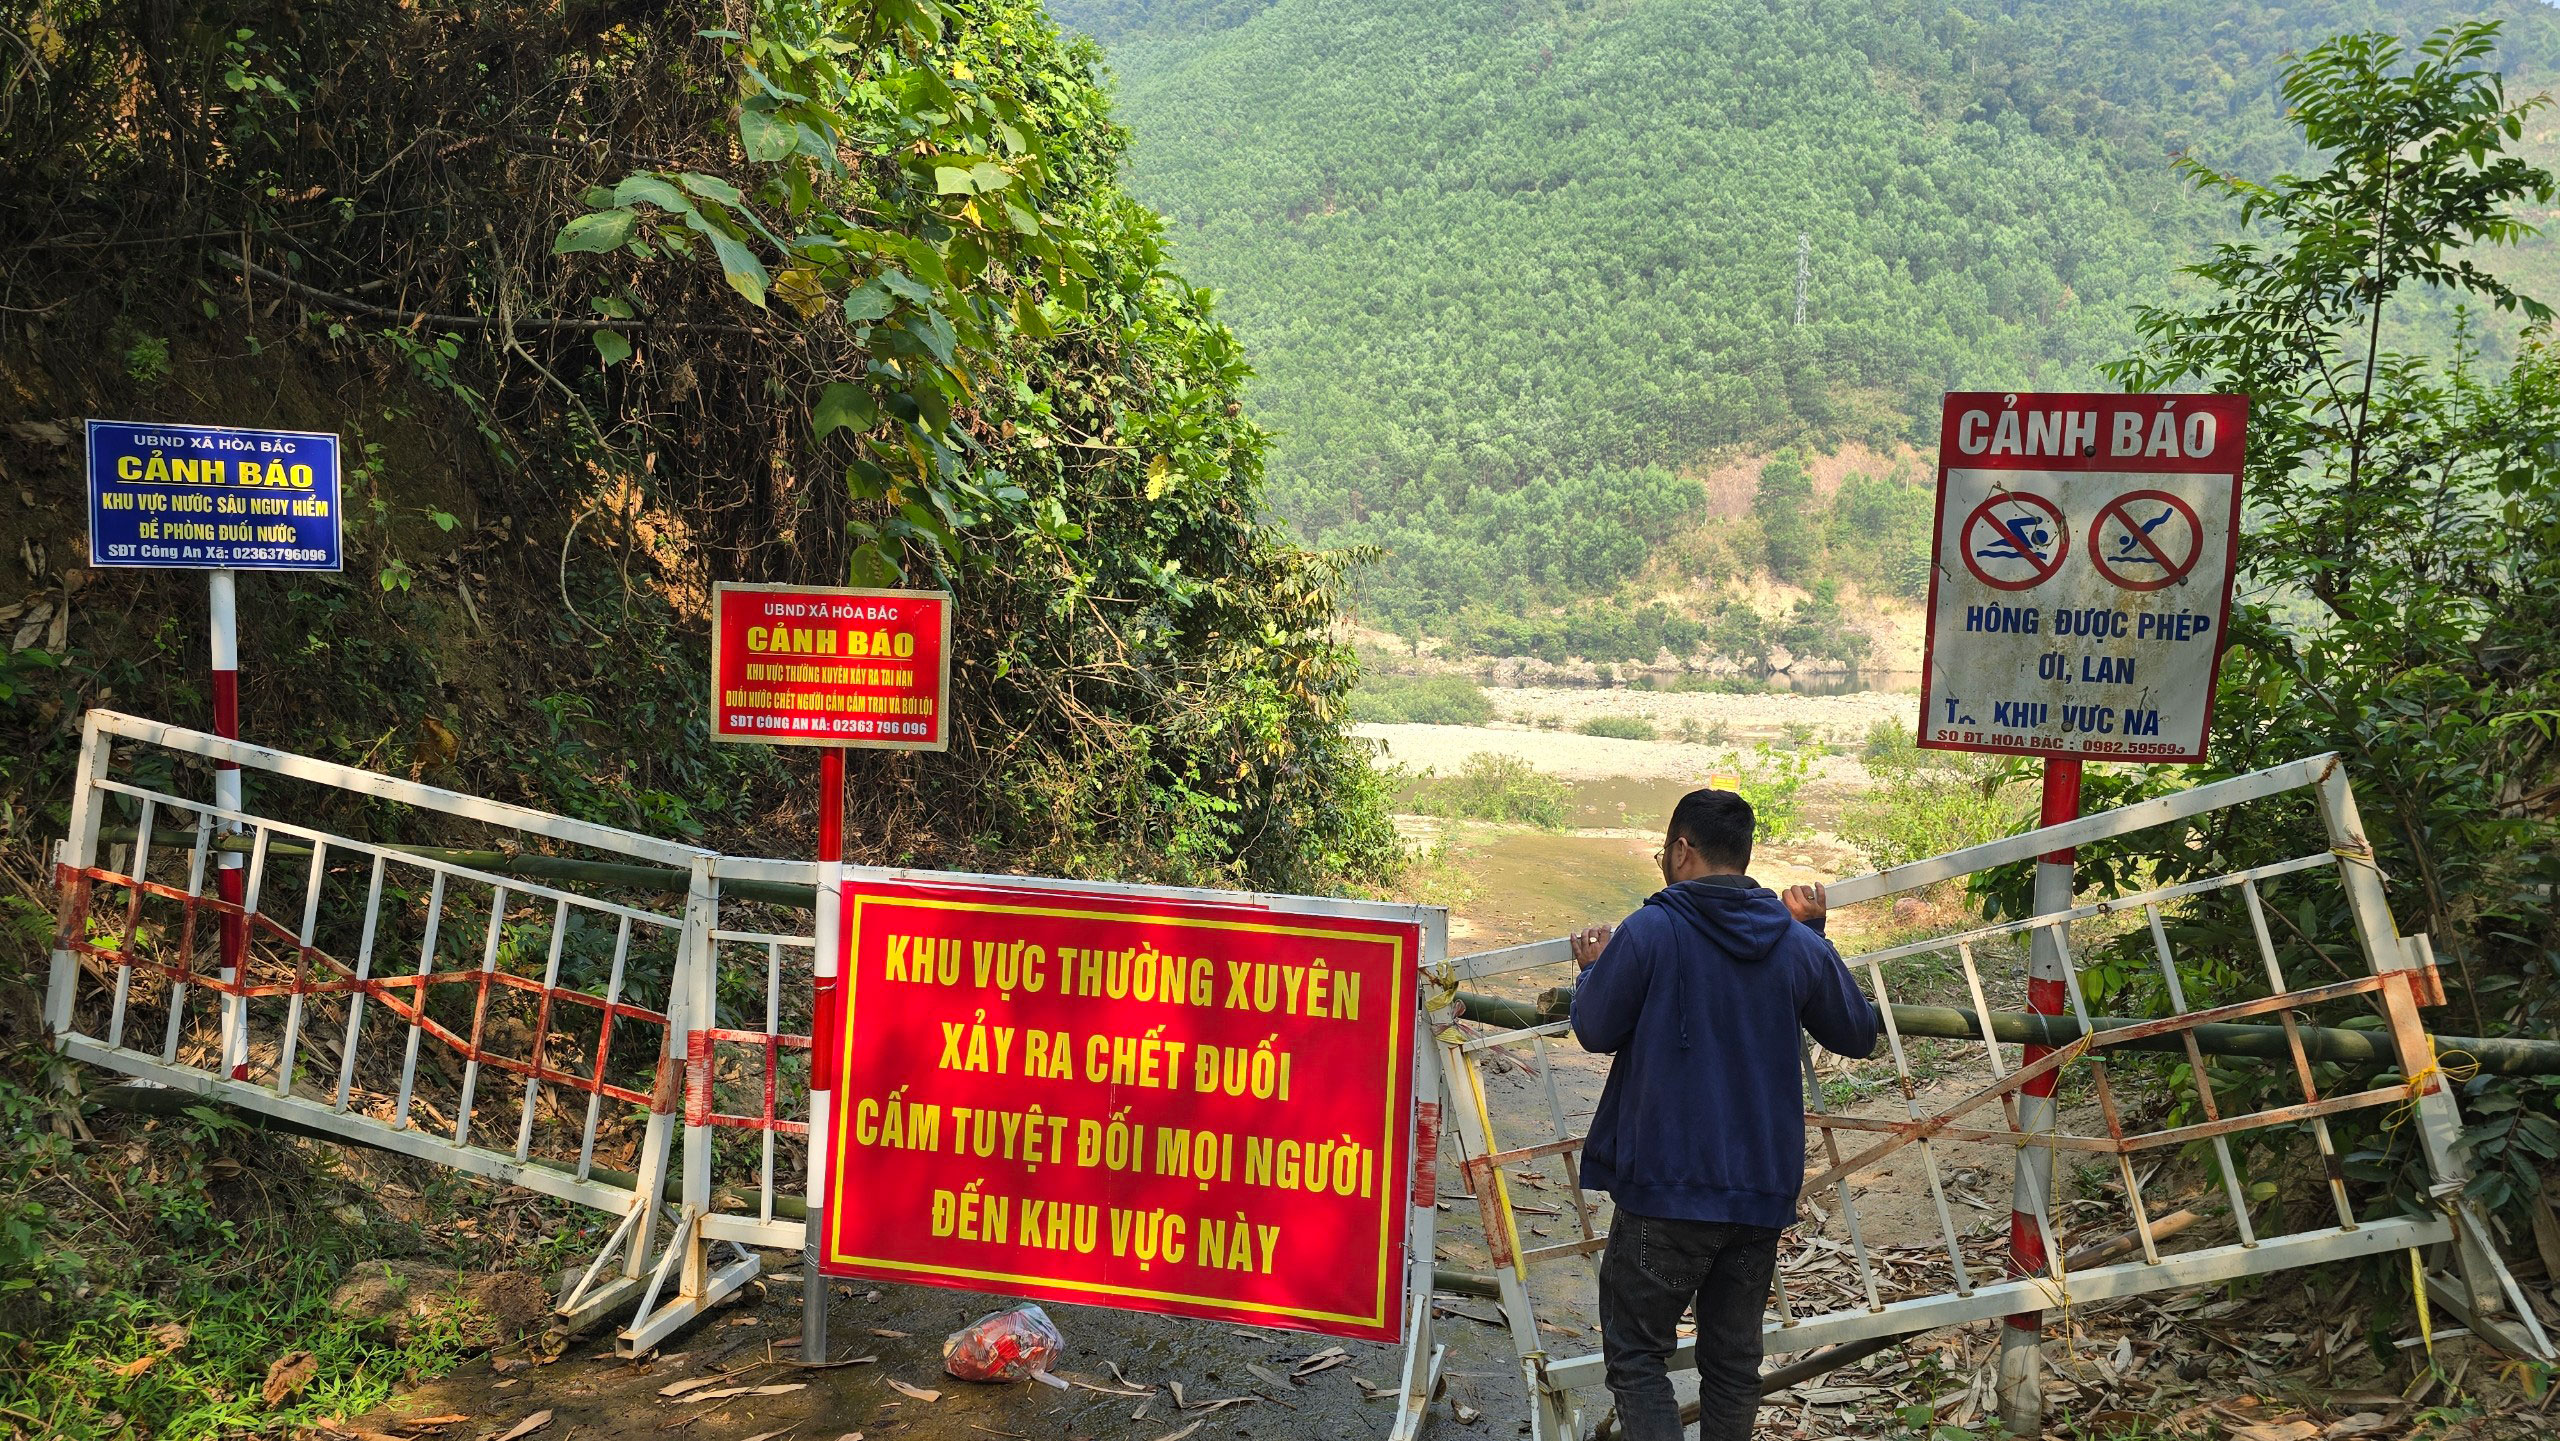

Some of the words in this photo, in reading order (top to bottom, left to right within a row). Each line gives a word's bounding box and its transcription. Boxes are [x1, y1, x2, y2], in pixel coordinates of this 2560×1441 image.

[1958, 393, 2098, 457] CẢNH
[2110, 400, 2217, 459] BÁO
[134, 434, 185, 447] UBND
[190, 436, 215, 449] XÃ
[219, 437, 256, 451] HÒA
[260, 439, 296, 454] BẮC
[117, 450, 225, 484] CẢNH
[238, 458, 313, 488] BÁO
[102, 492, 134, 510] KHU
[137, 492, 167, 515] VỰC
[171, 493, 213, 513] NƯỚC
[217, 493, 247, 514] SÂU
[250, 498, 289, 516] NGUY
[292, 494, 329, 517] HIỂM
[139, 517, 160, 539] ĐỀ
[163, 519, 215, 541] PHÒNG
[218, 520, 253, 542] ĐUỐI
[257, 523, 297, 544] NƯỚC
[108, 544, 137, 557] SĐT
[141, 544, 179, 559] Công
[182, 545, 202, 558] An
[205, 546, 229, 559] Xã:
[232, 547, 327, 561] 02363796096
[764, 603, 805, 617] UBND
[808, 602, 829, 618] XÃ
[832, 603, 865, 620] HÒA
[2054, 607, 2129, 644] ĐƯỢC
[2137, 608, 2211, 642] PHÉP
[747, 622, 837, 654] CẢNH
[848, 628, 914, 658] BÁO
[746, 663, 765, 681] KHU
[766, 662, 784, 685] VỰC
[785, 663, 820, 683] THƯỜNG
[821, 664, 849, 684] XUYÊN
[867, 668, 880, 686] RA
[881, 669, 894, 687] TAI
[895, 670, 914, 690] NẠN
[773, 688, 796, 710] CHẾT
[867, 696, 887, 717] TRẠI
[888, 694, 901, 715] VÀ
[1993, 700, 2048, 728] KHU
[756, 714, 790, 730] CÔNG
[791, 717, 809, 731] AN
[832, 719, 874, 732] 02363
[876, 720, 900, 734] 796
[902, 722, 927, 735] 096
[886, 935, 961, 985] KHU
[973, 940, 1045, 1001] VỰC
[1058, 942, 1213, 1006] THƯỜNG
[1225, 958, 1360, 1020] XUYÊN
[939, 1009, 1014, 1074] XẢY
[1025, 1030, 1072, 1079] RA
[1086, 1025, 1185, 1089] CHẾT
[1195, 1033, 1290, 1101] ĐUỐI
[857, 1085, 940, 1151] CẤM
[952, 1104, 1067, 1172] TUYỆT
[1078, 1106, 1143, 1172] ĐỐI
[1156, 1127, 1232, 1190] MỌI
[1245, 1134, 1372, 1198] NGƯỜI
[932, 1179, 1008, 1243] ĐẾN
[1020, 1199, 1097, 1253] KHU
[1111, 1208, 1185, 1271] VỰC
[1199, 1212, 1280, 1274] NÀY
